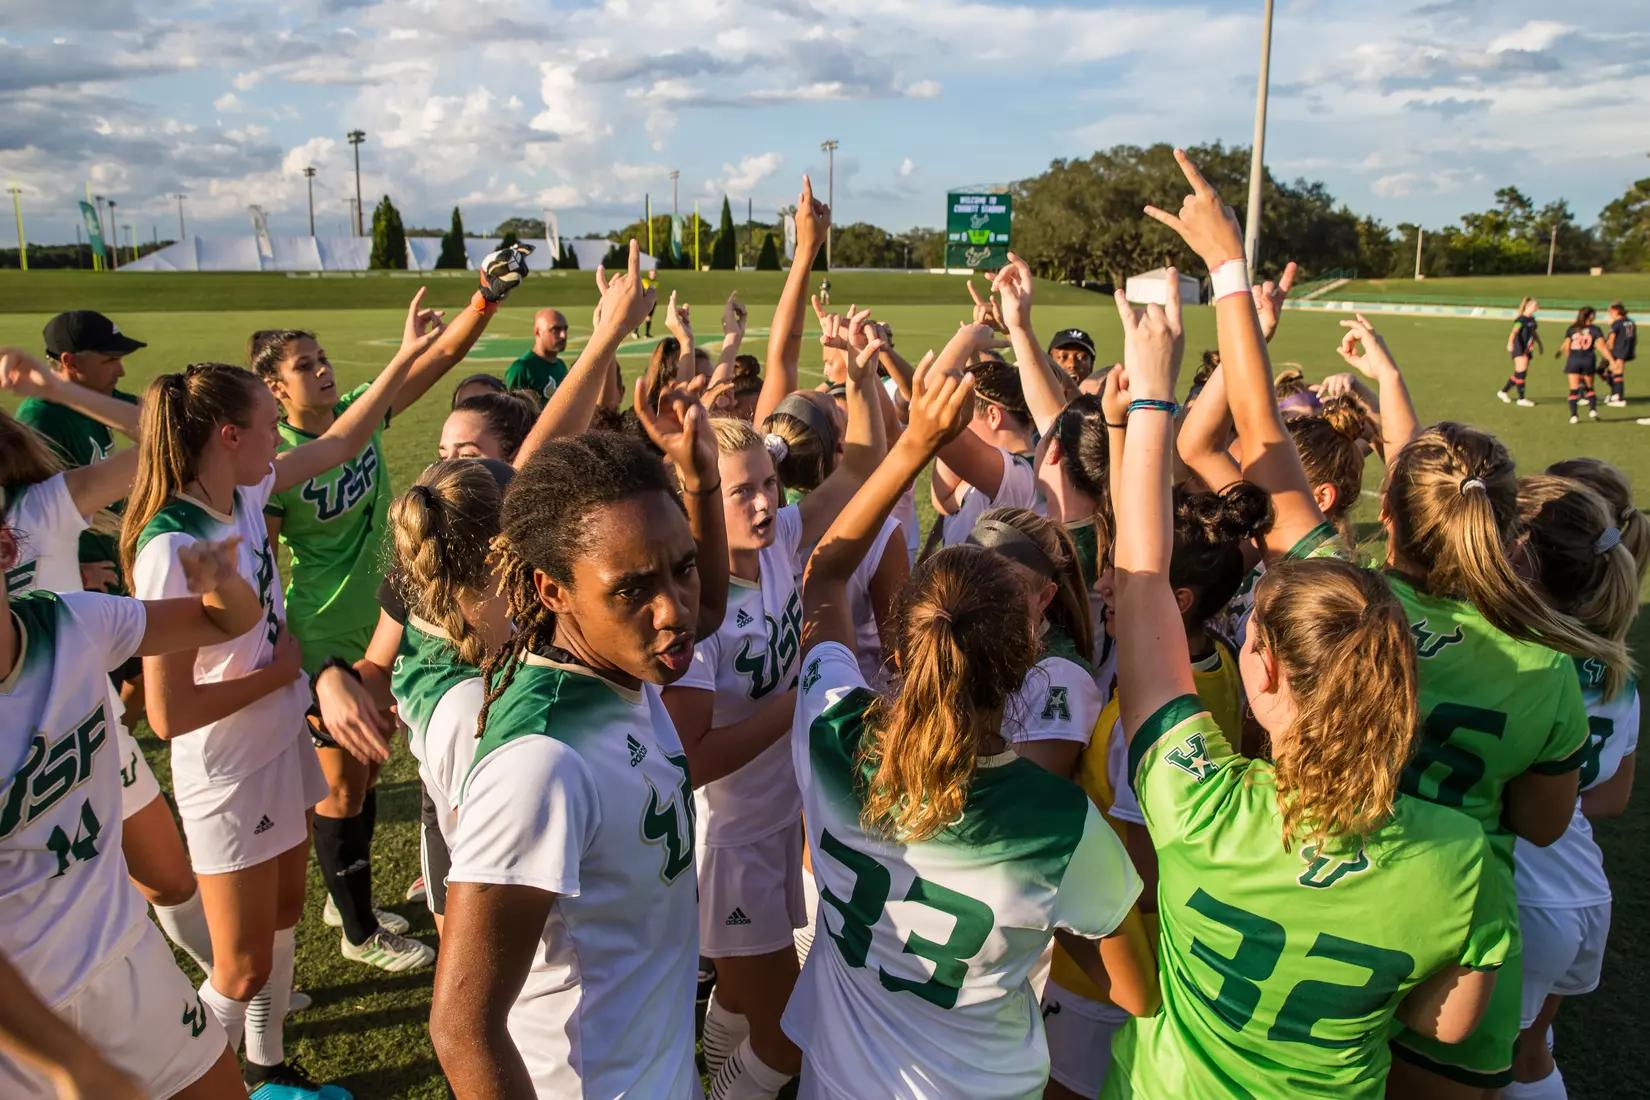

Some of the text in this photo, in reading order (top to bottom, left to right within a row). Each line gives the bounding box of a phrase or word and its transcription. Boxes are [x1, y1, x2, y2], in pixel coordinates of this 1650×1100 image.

[737, 616, 754, 628] adidas
[820, 827, 995, 1010] 33
[1177, 887, 1415, 1049] 32
